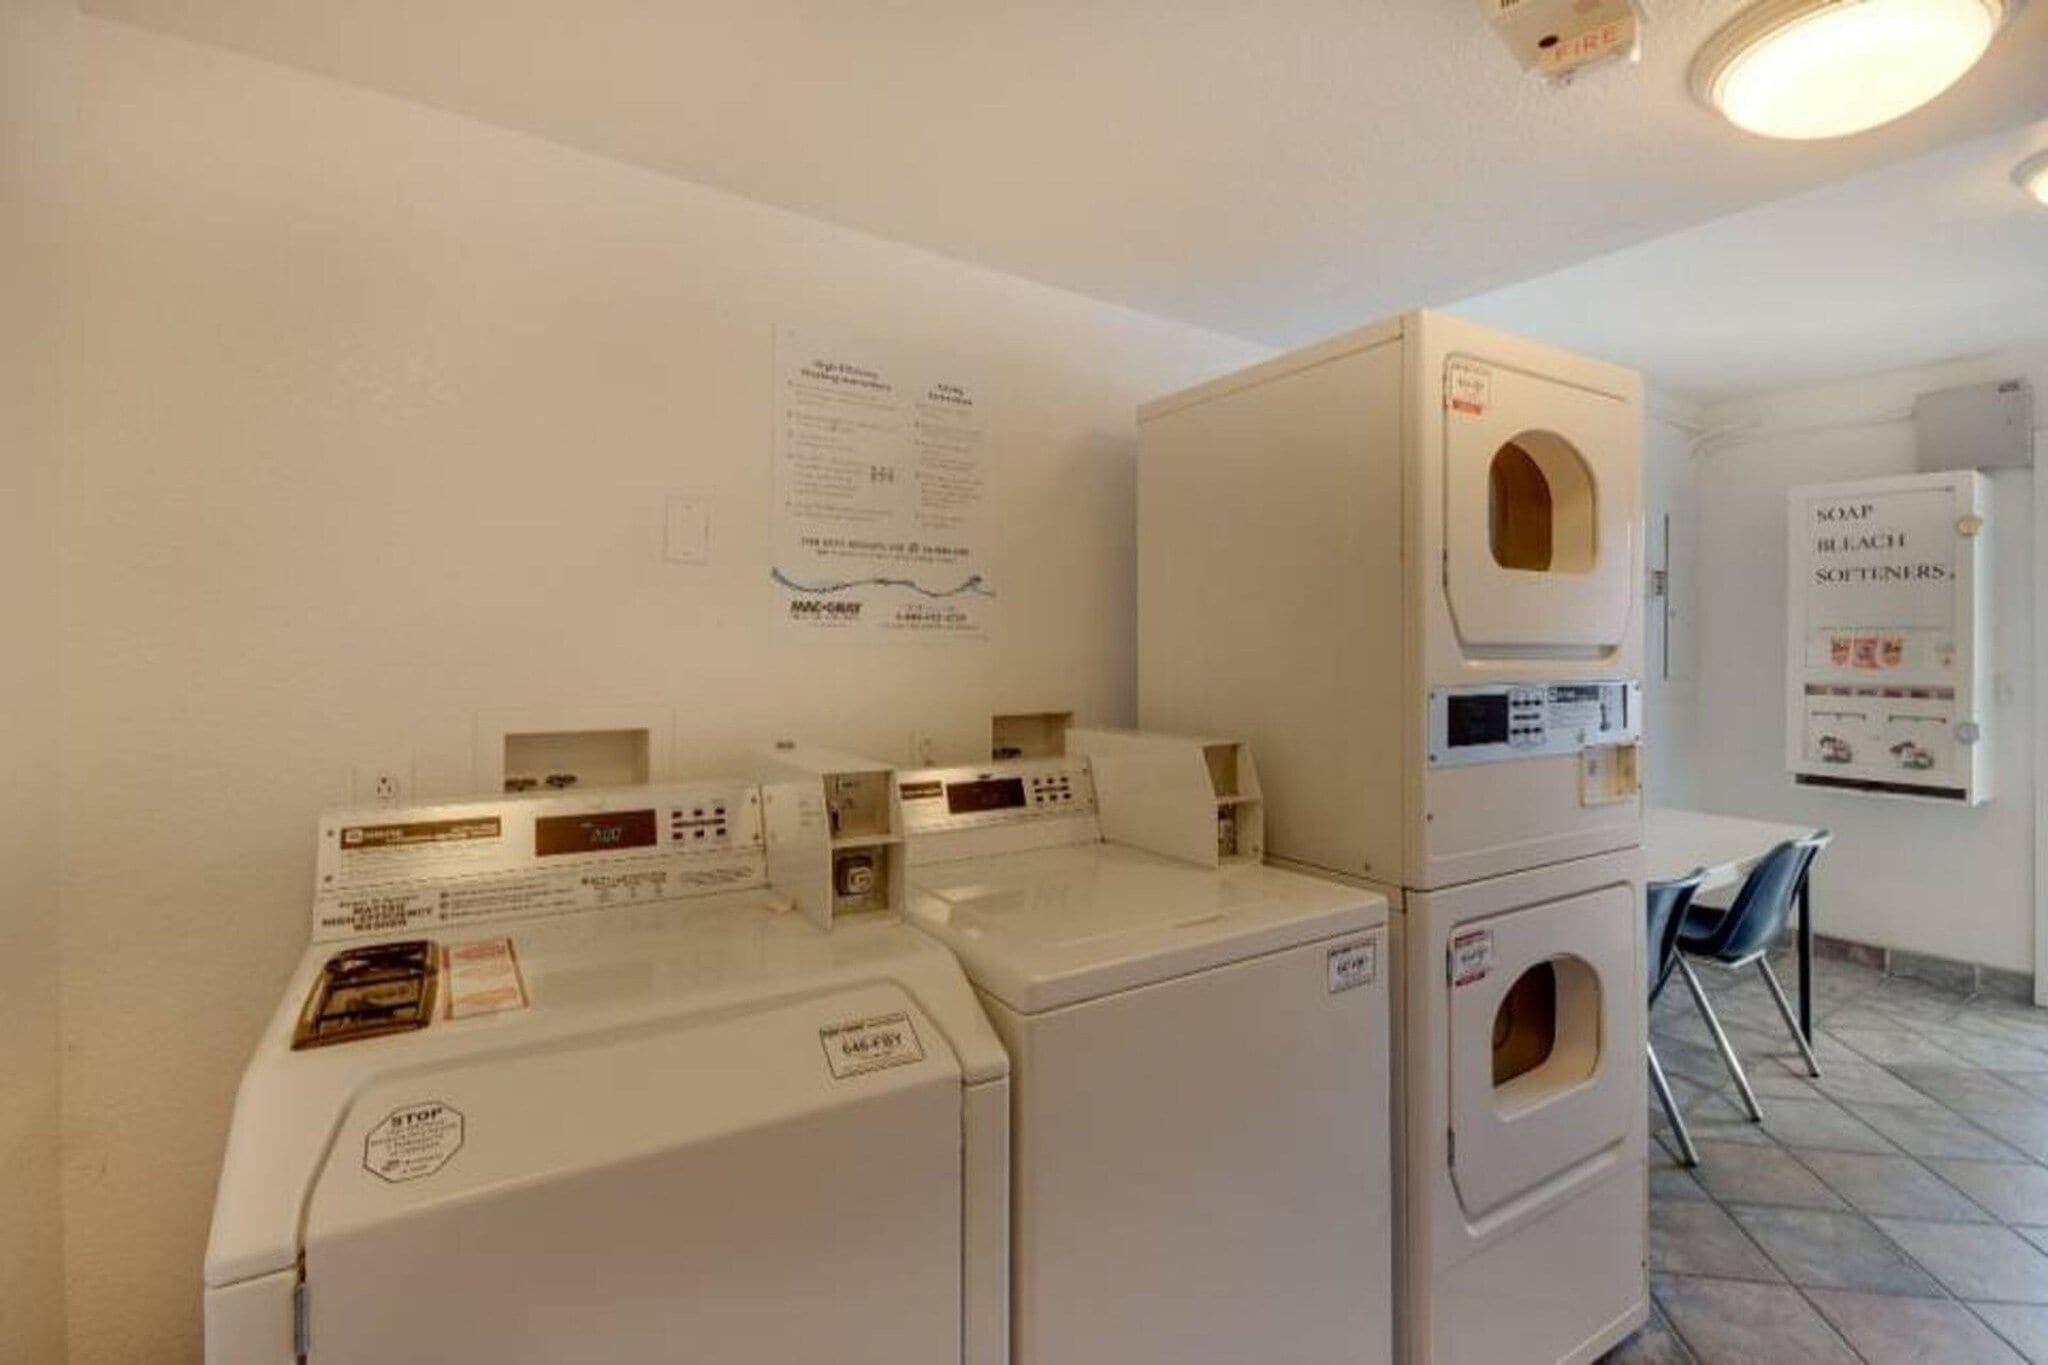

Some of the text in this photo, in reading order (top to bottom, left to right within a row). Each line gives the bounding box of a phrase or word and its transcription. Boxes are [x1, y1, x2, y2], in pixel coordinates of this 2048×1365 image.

[1553, 26, 1616, 61] FIRE
[1816, 505, 1873, 523] SOAP
[1817, 532, 1905, 553] BLEACH
[1815, 564, 1945, 585] SOFTENERS
[391, 1107, 442, 1128] STOP
